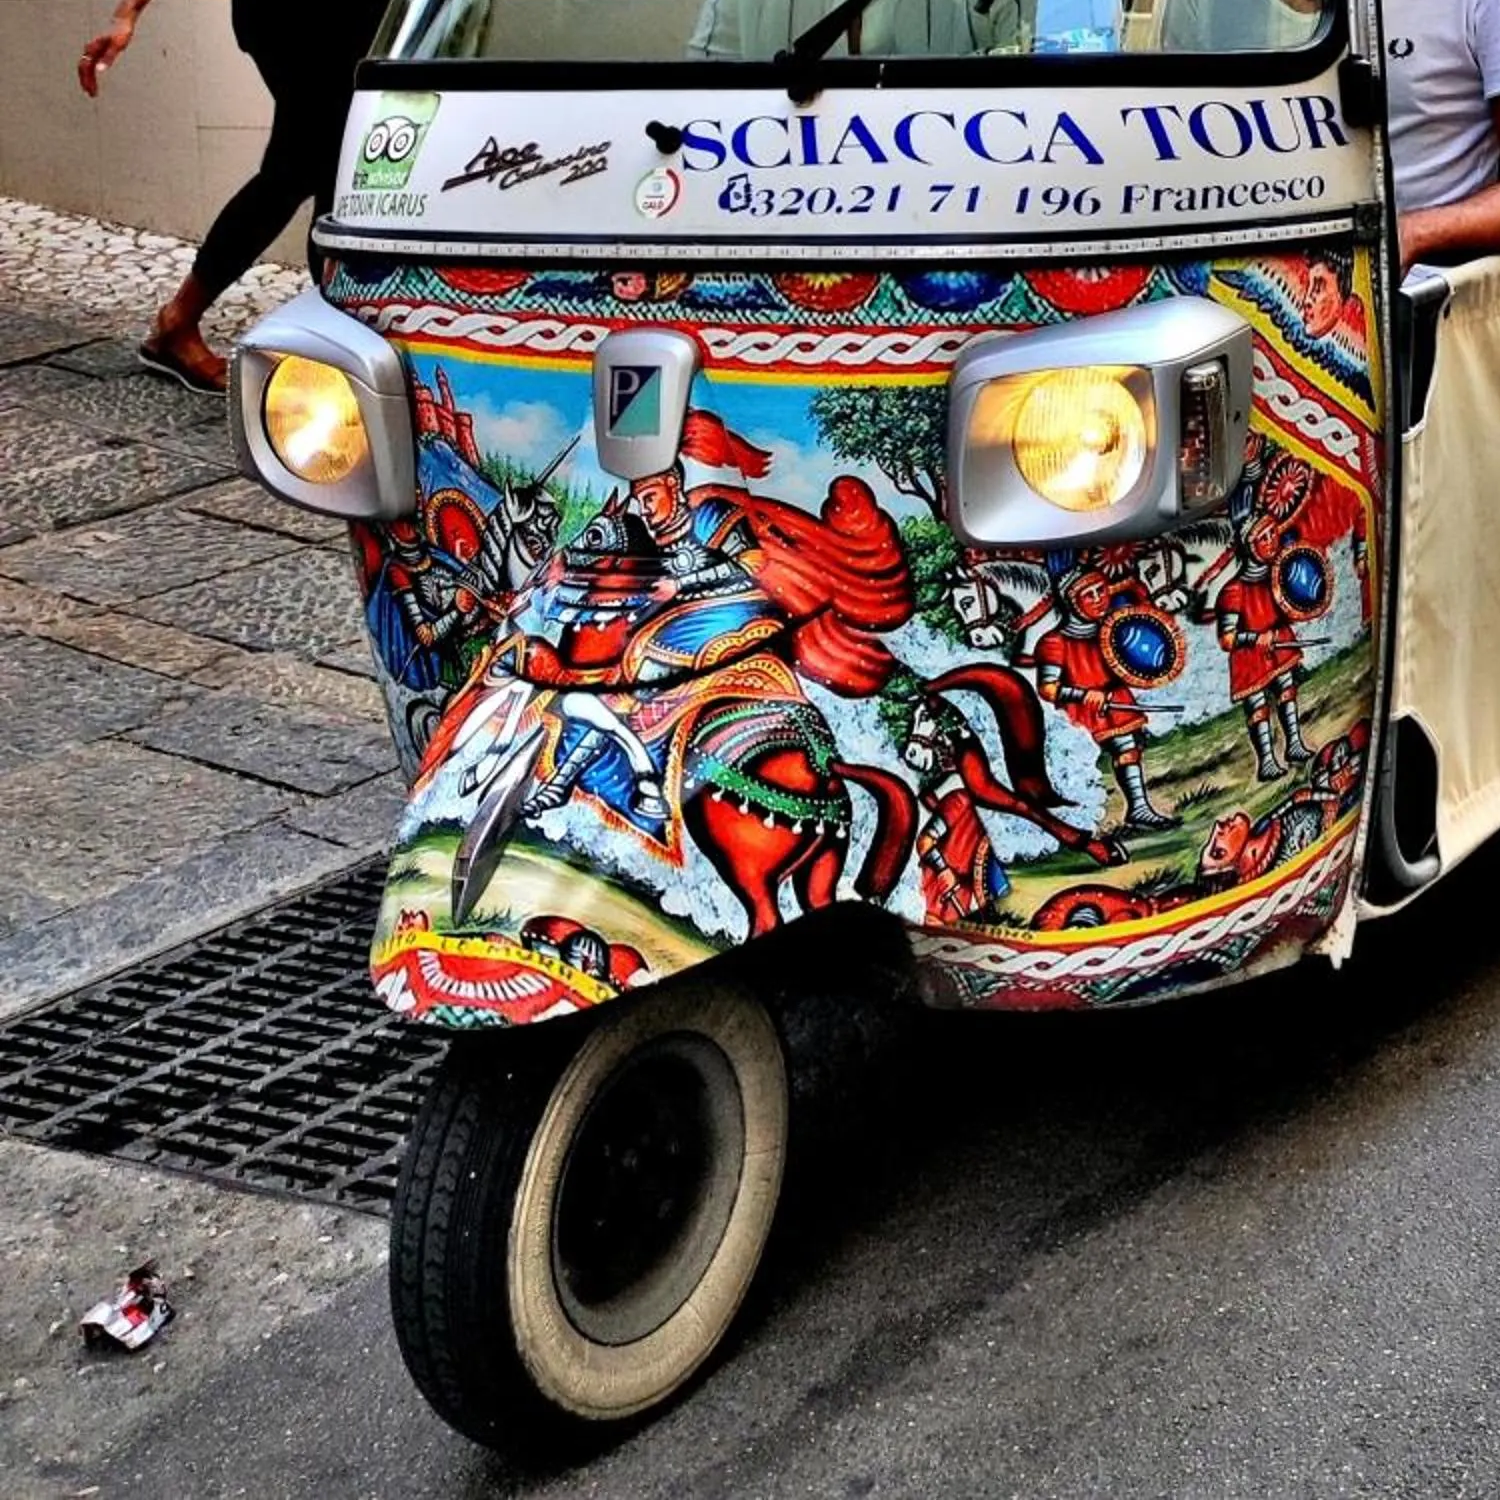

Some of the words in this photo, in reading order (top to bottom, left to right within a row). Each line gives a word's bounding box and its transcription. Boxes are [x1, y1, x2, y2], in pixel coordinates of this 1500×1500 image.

[681, 108, 1105, 172] SCIACCA
[1120, 94, 1350, 161] TOUR
[375, 192, 429, 218] ICARUS
[1119, 174, 1326, 215] Francesco
[611, 368, 642, 417] P
